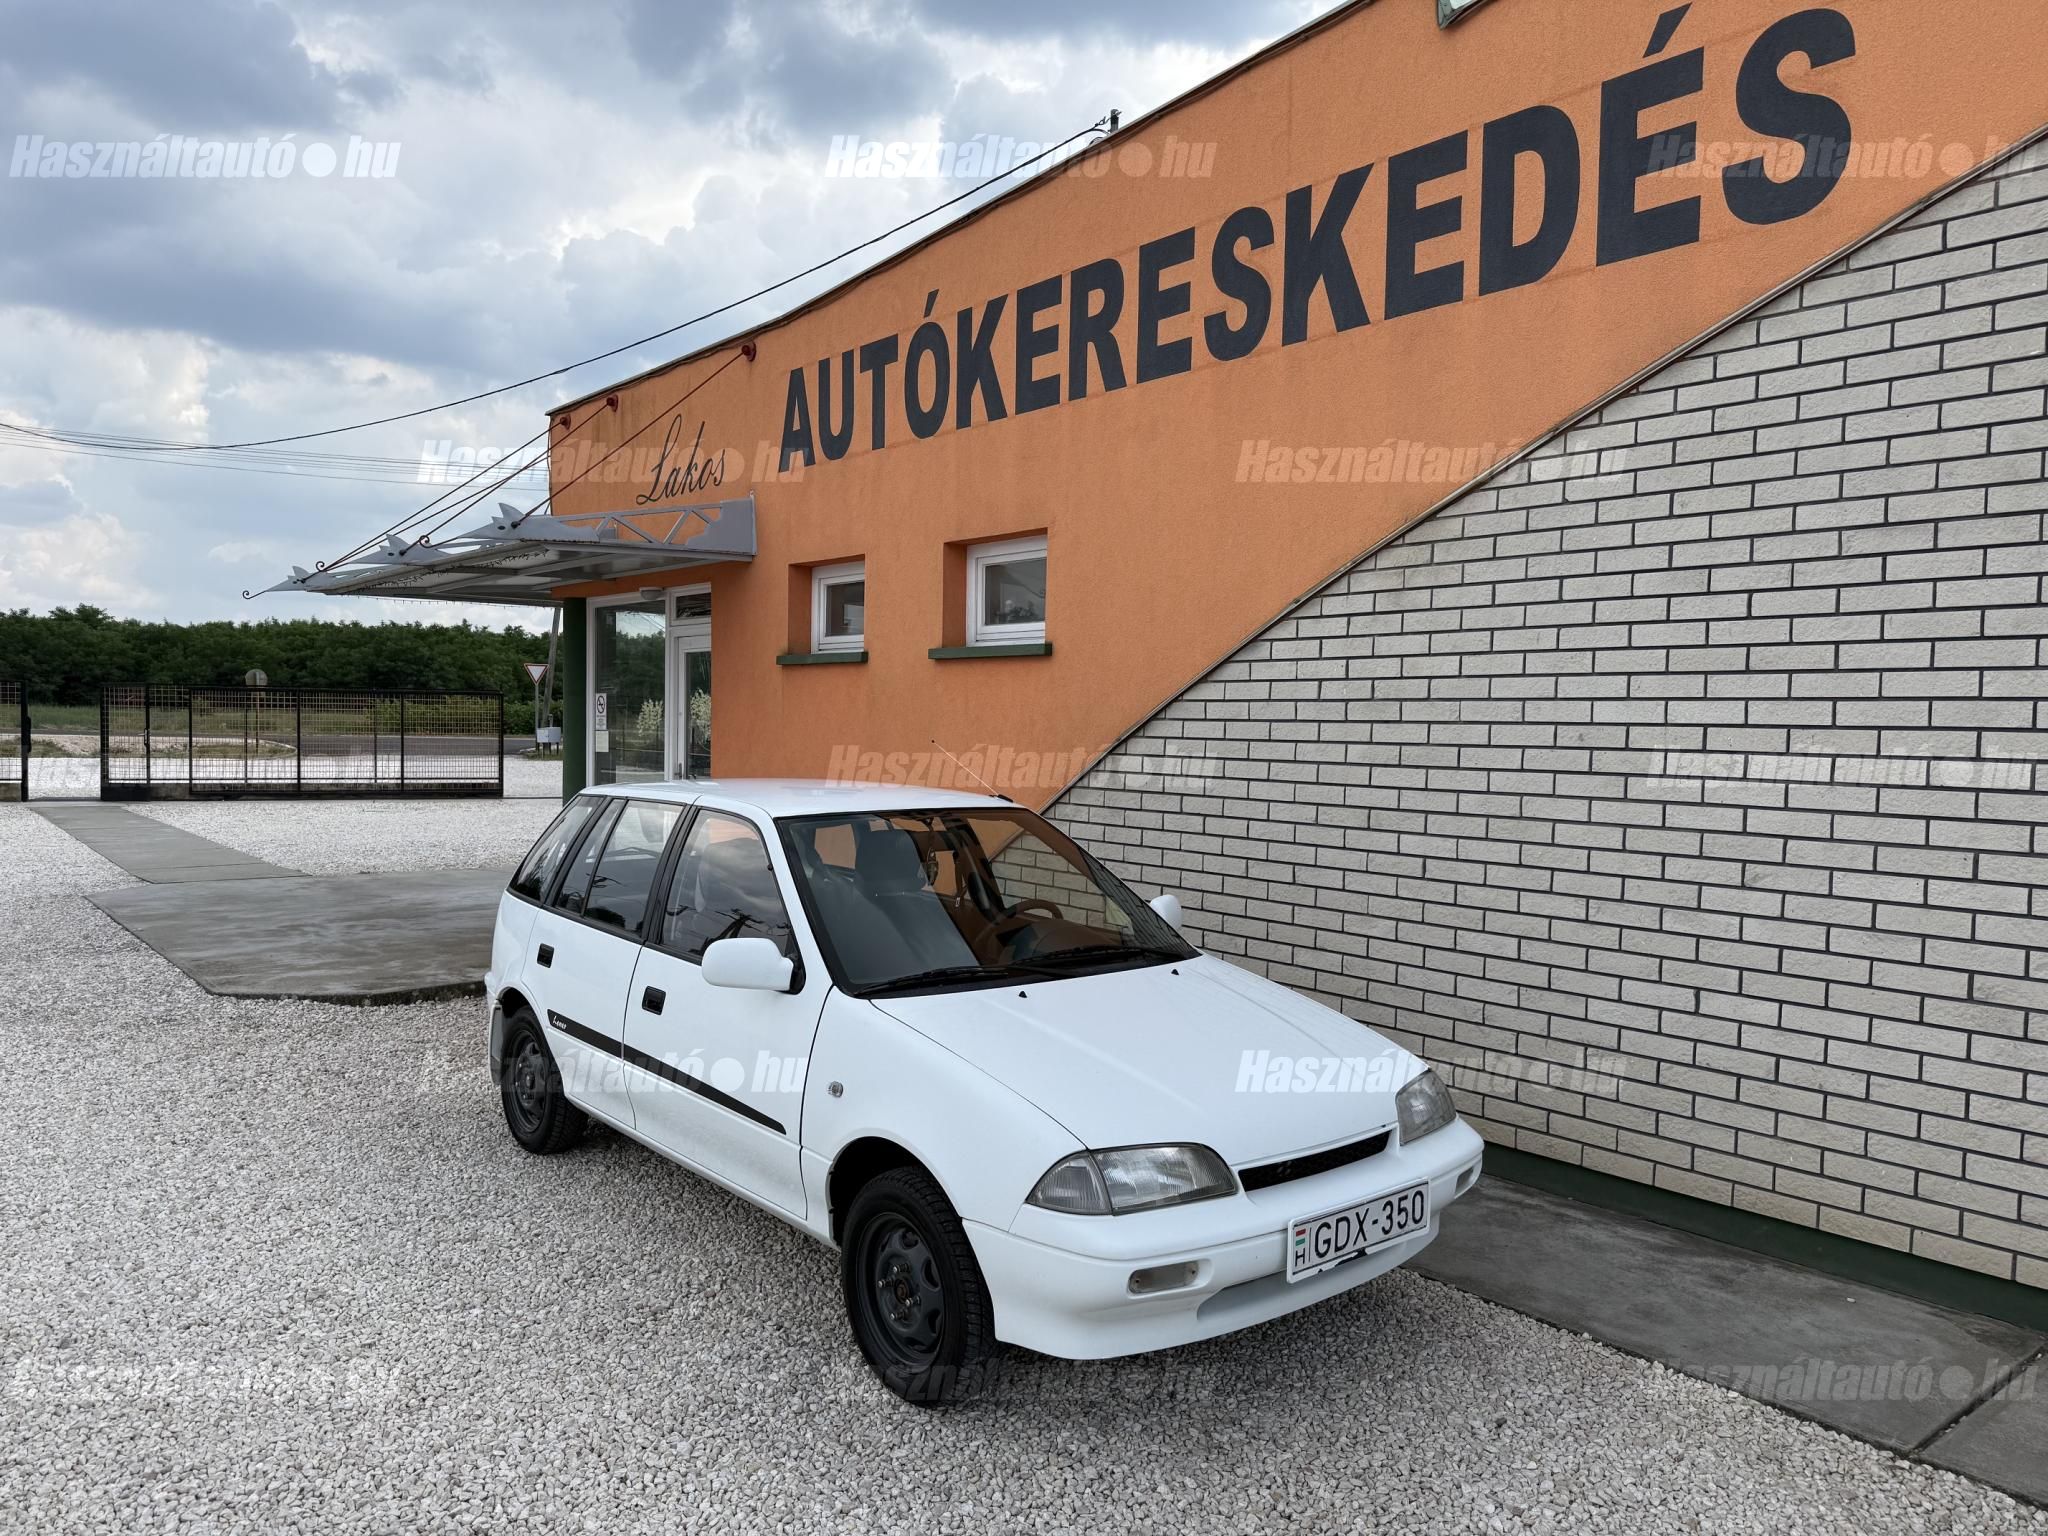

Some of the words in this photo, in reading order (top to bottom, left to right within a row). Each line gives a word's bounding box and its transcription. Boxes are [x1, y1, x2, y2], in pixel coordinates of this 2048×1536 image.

[778, 2, 1856, 473] AUTÓKERESKEDÉS
[636, 413, 726, 505] Lakos
[1295, 1247, 1306, 1267] H
[1314, 1189, 1425, 1259] GDX-350
